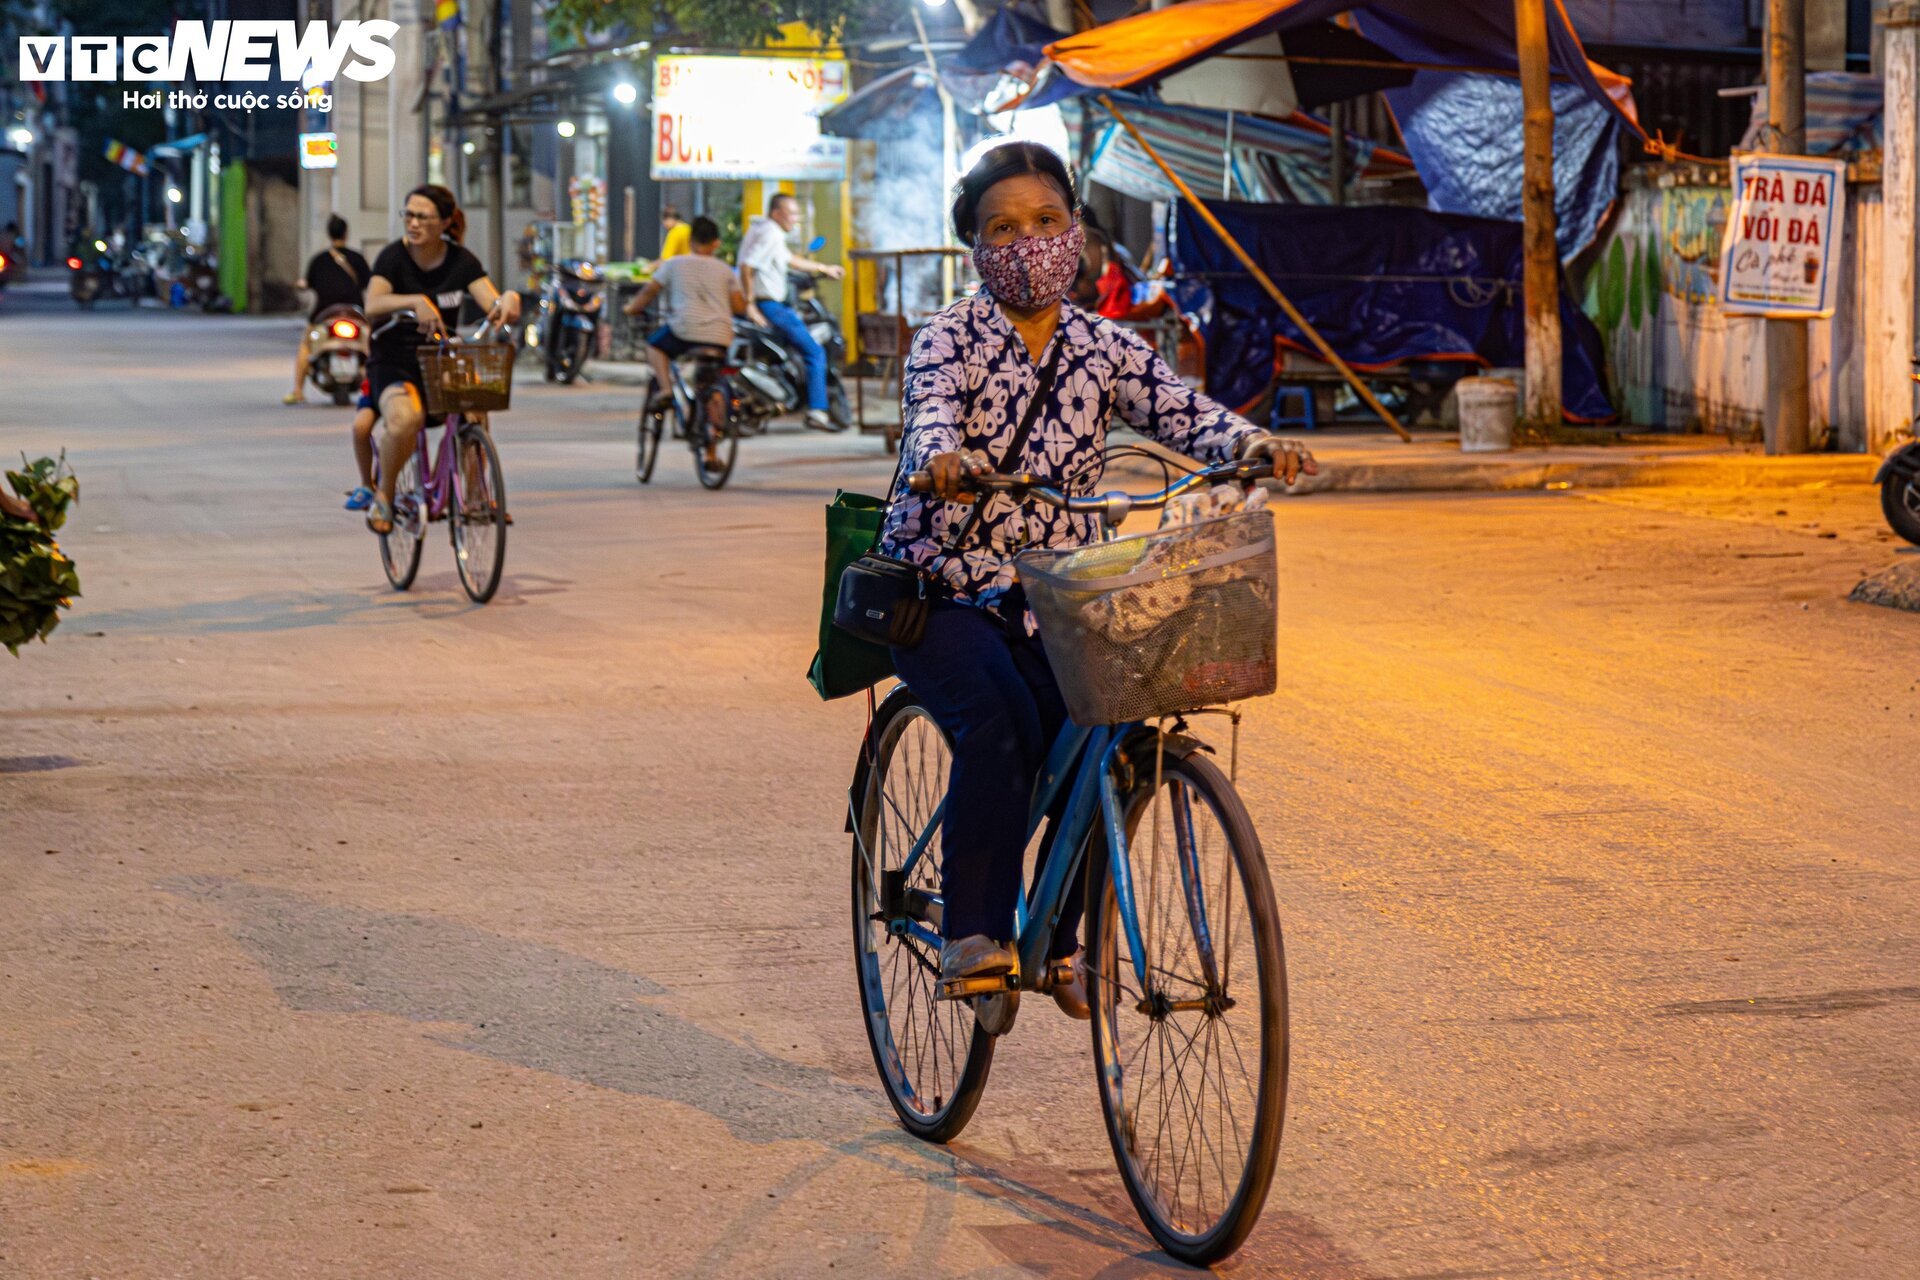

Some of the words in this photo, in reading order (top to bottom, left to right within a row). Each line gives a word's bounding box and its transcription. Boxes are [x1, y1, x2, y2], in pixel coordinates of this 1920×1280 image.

[1743, 171, 1785, 203] TRÀ
[1794, 175, 1827, 206] ĐÁ
[1787, 214, 1820, 246] ĐÁ
